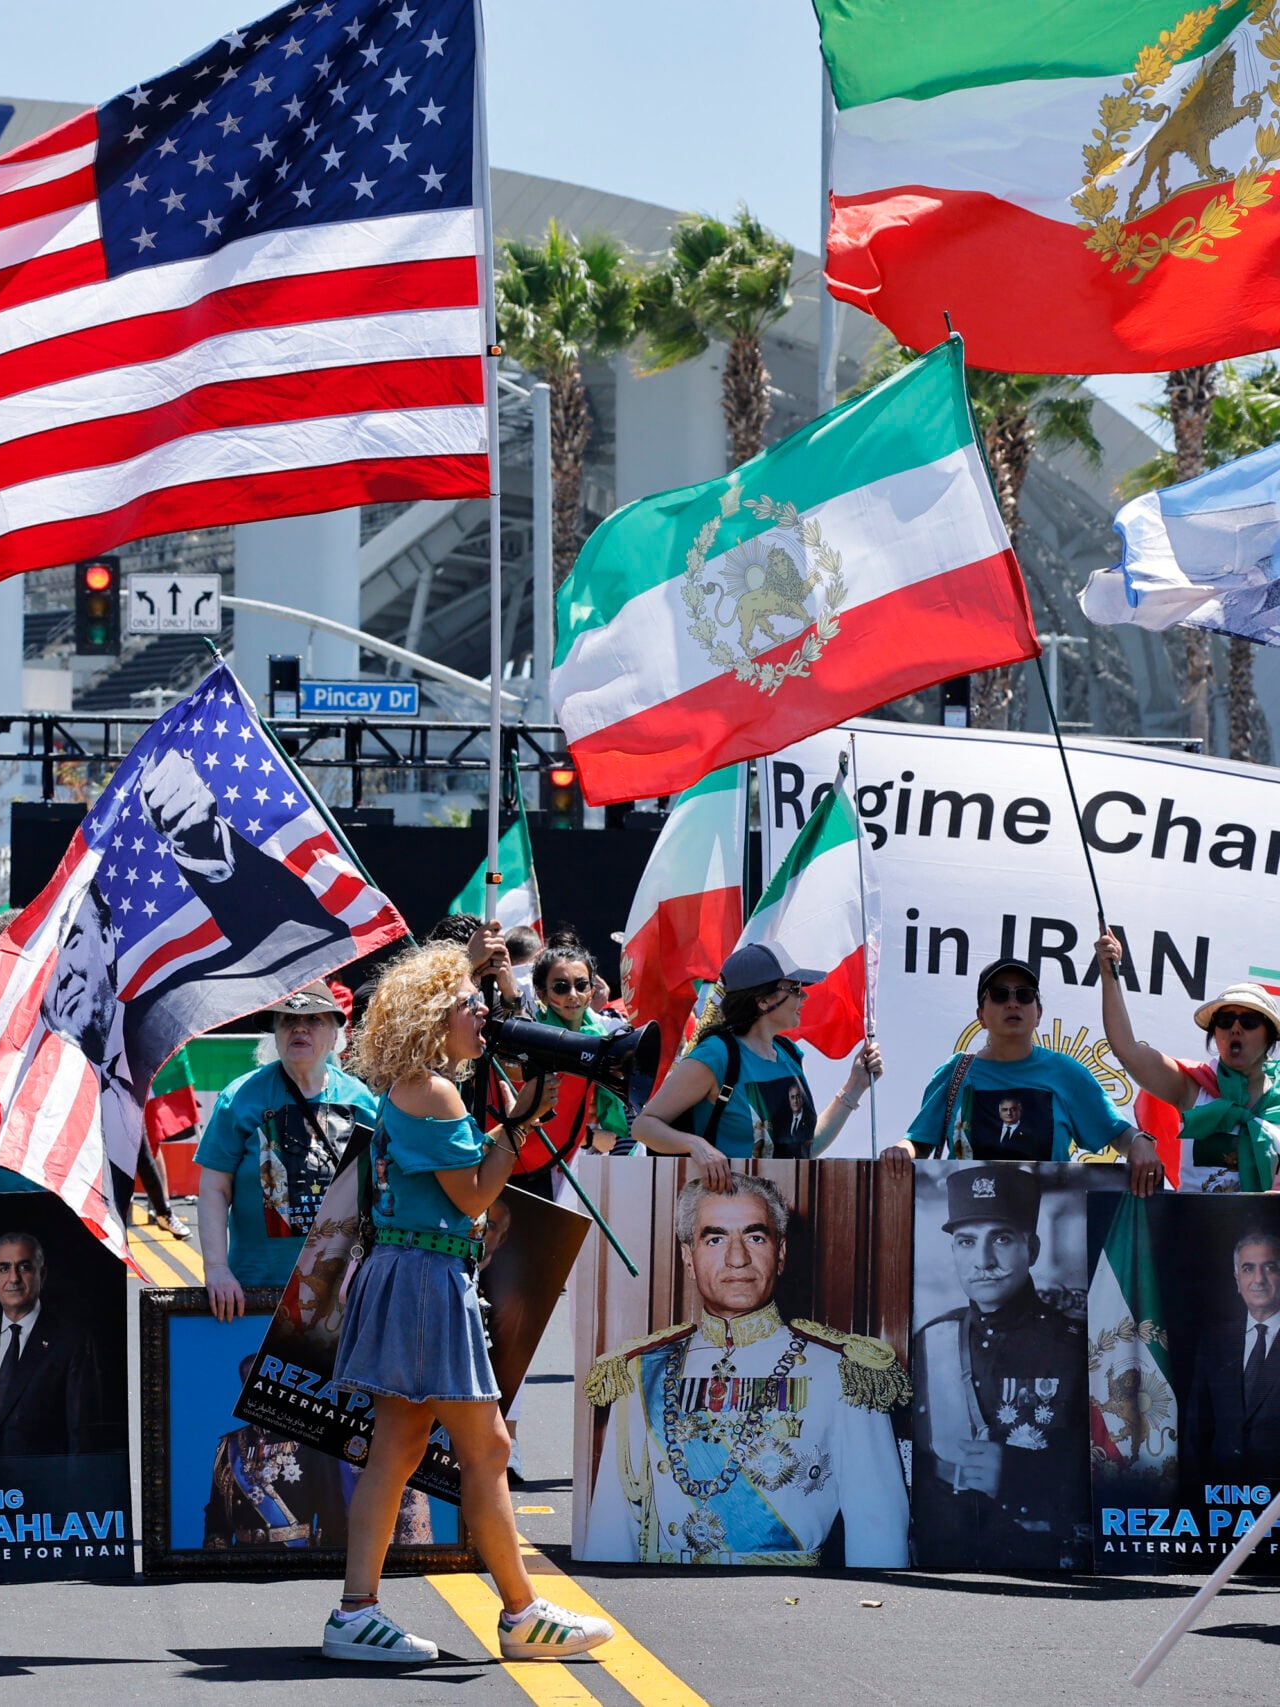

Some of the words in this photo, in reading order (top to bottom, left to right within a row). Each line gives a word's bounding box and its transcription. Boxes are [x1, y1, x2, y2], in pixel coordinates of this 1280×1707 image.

[133, 618, 156, 628] ONLY
[162, 618, 185, 628] ONLY
[192, 618, 216, 628] ONLY
[314, 687, 382, 711] Pincay
[389, 689, 412, 710] Dr
[905, 907, 970, 976] in
[1000, 914, 1210, 1001] IRAN
[258, 1354, 339, 1406] REZA
[253, 1381, 375, 1436] ALTERNATIV
[1205, 1485, 1271, 1505] KING
[1101, 1508, 1200, 1537] REZA
[24, 1546, 63, 1560] FOR
[76, 1545, 125, 1557] IRAN
